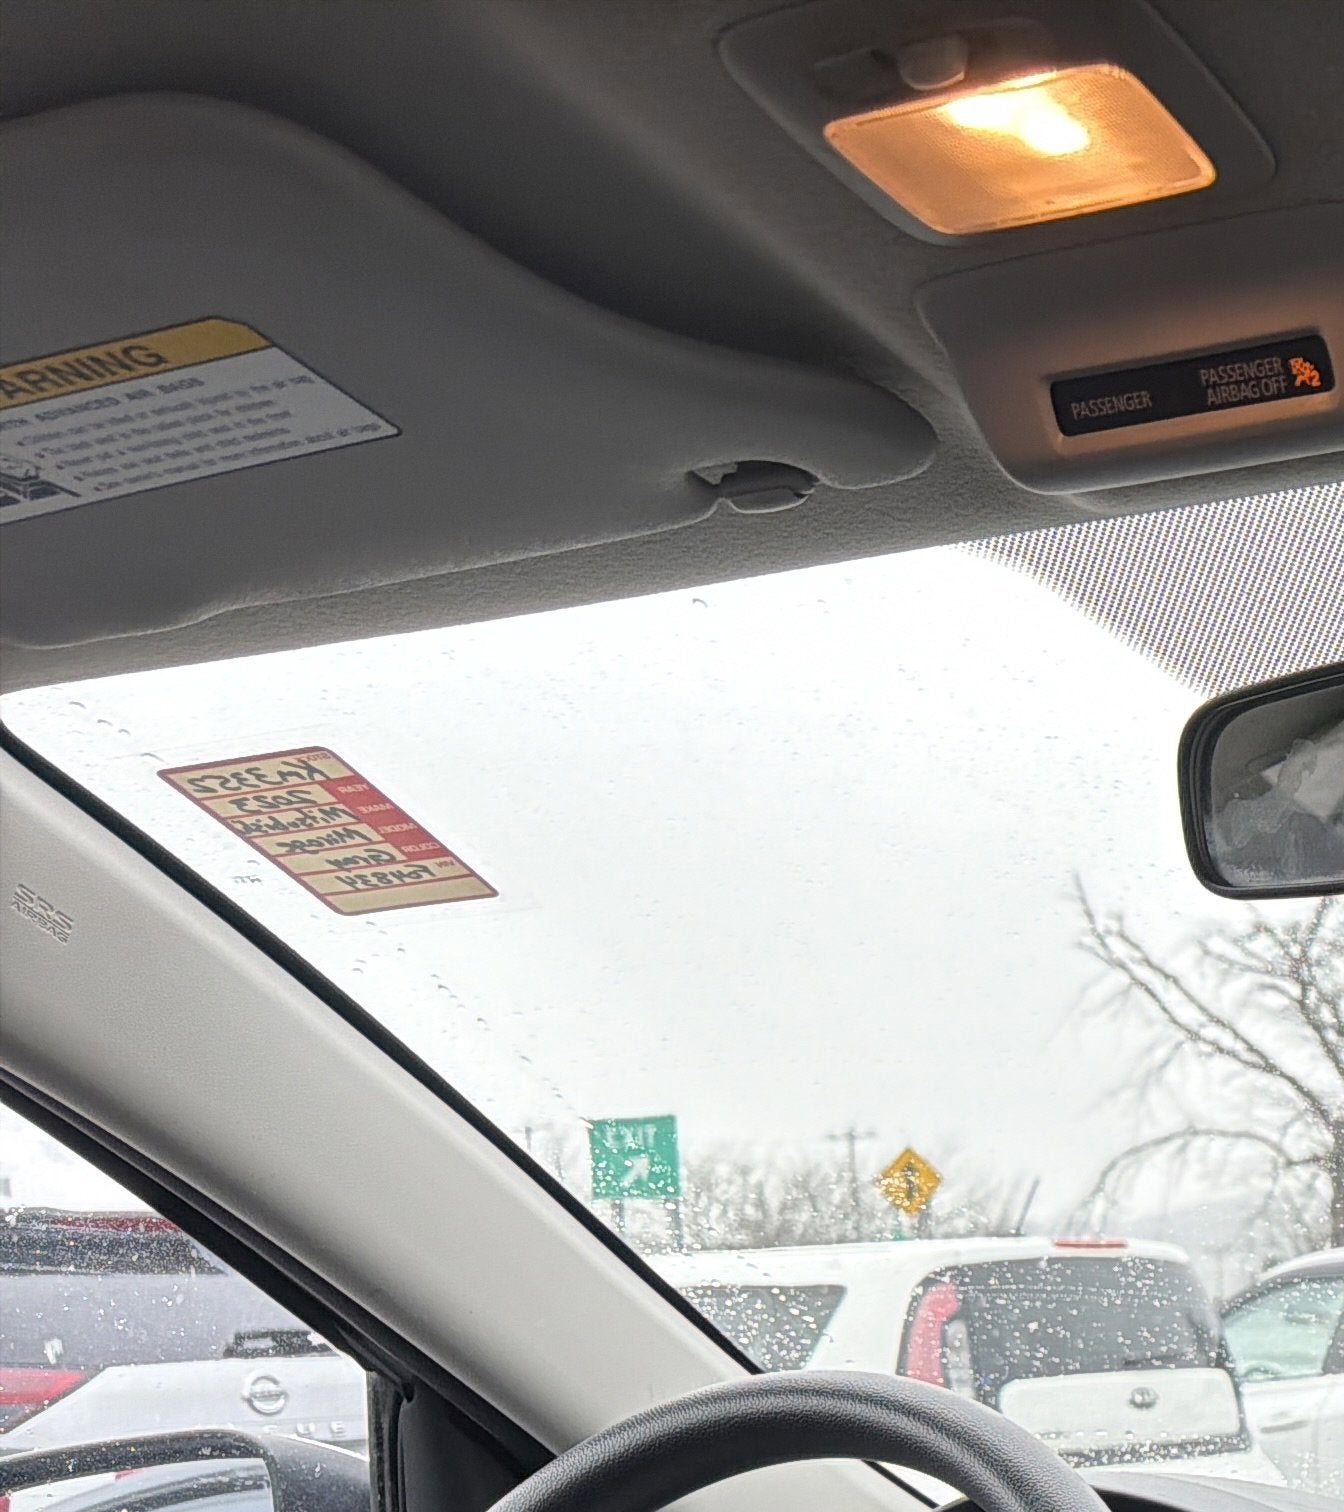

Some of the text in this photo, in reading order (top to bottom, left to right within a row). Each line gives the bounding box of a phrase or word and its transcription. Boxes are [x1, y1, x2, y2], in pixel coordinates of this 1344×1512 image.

[0, 344, 168, 400] ARNING
[1200, 357, 1284, 387] PASSENGER
[1070, 390, 1152, 420] PASSENGER
[1206, 375, 1289, 407] AIRBAG OFF
